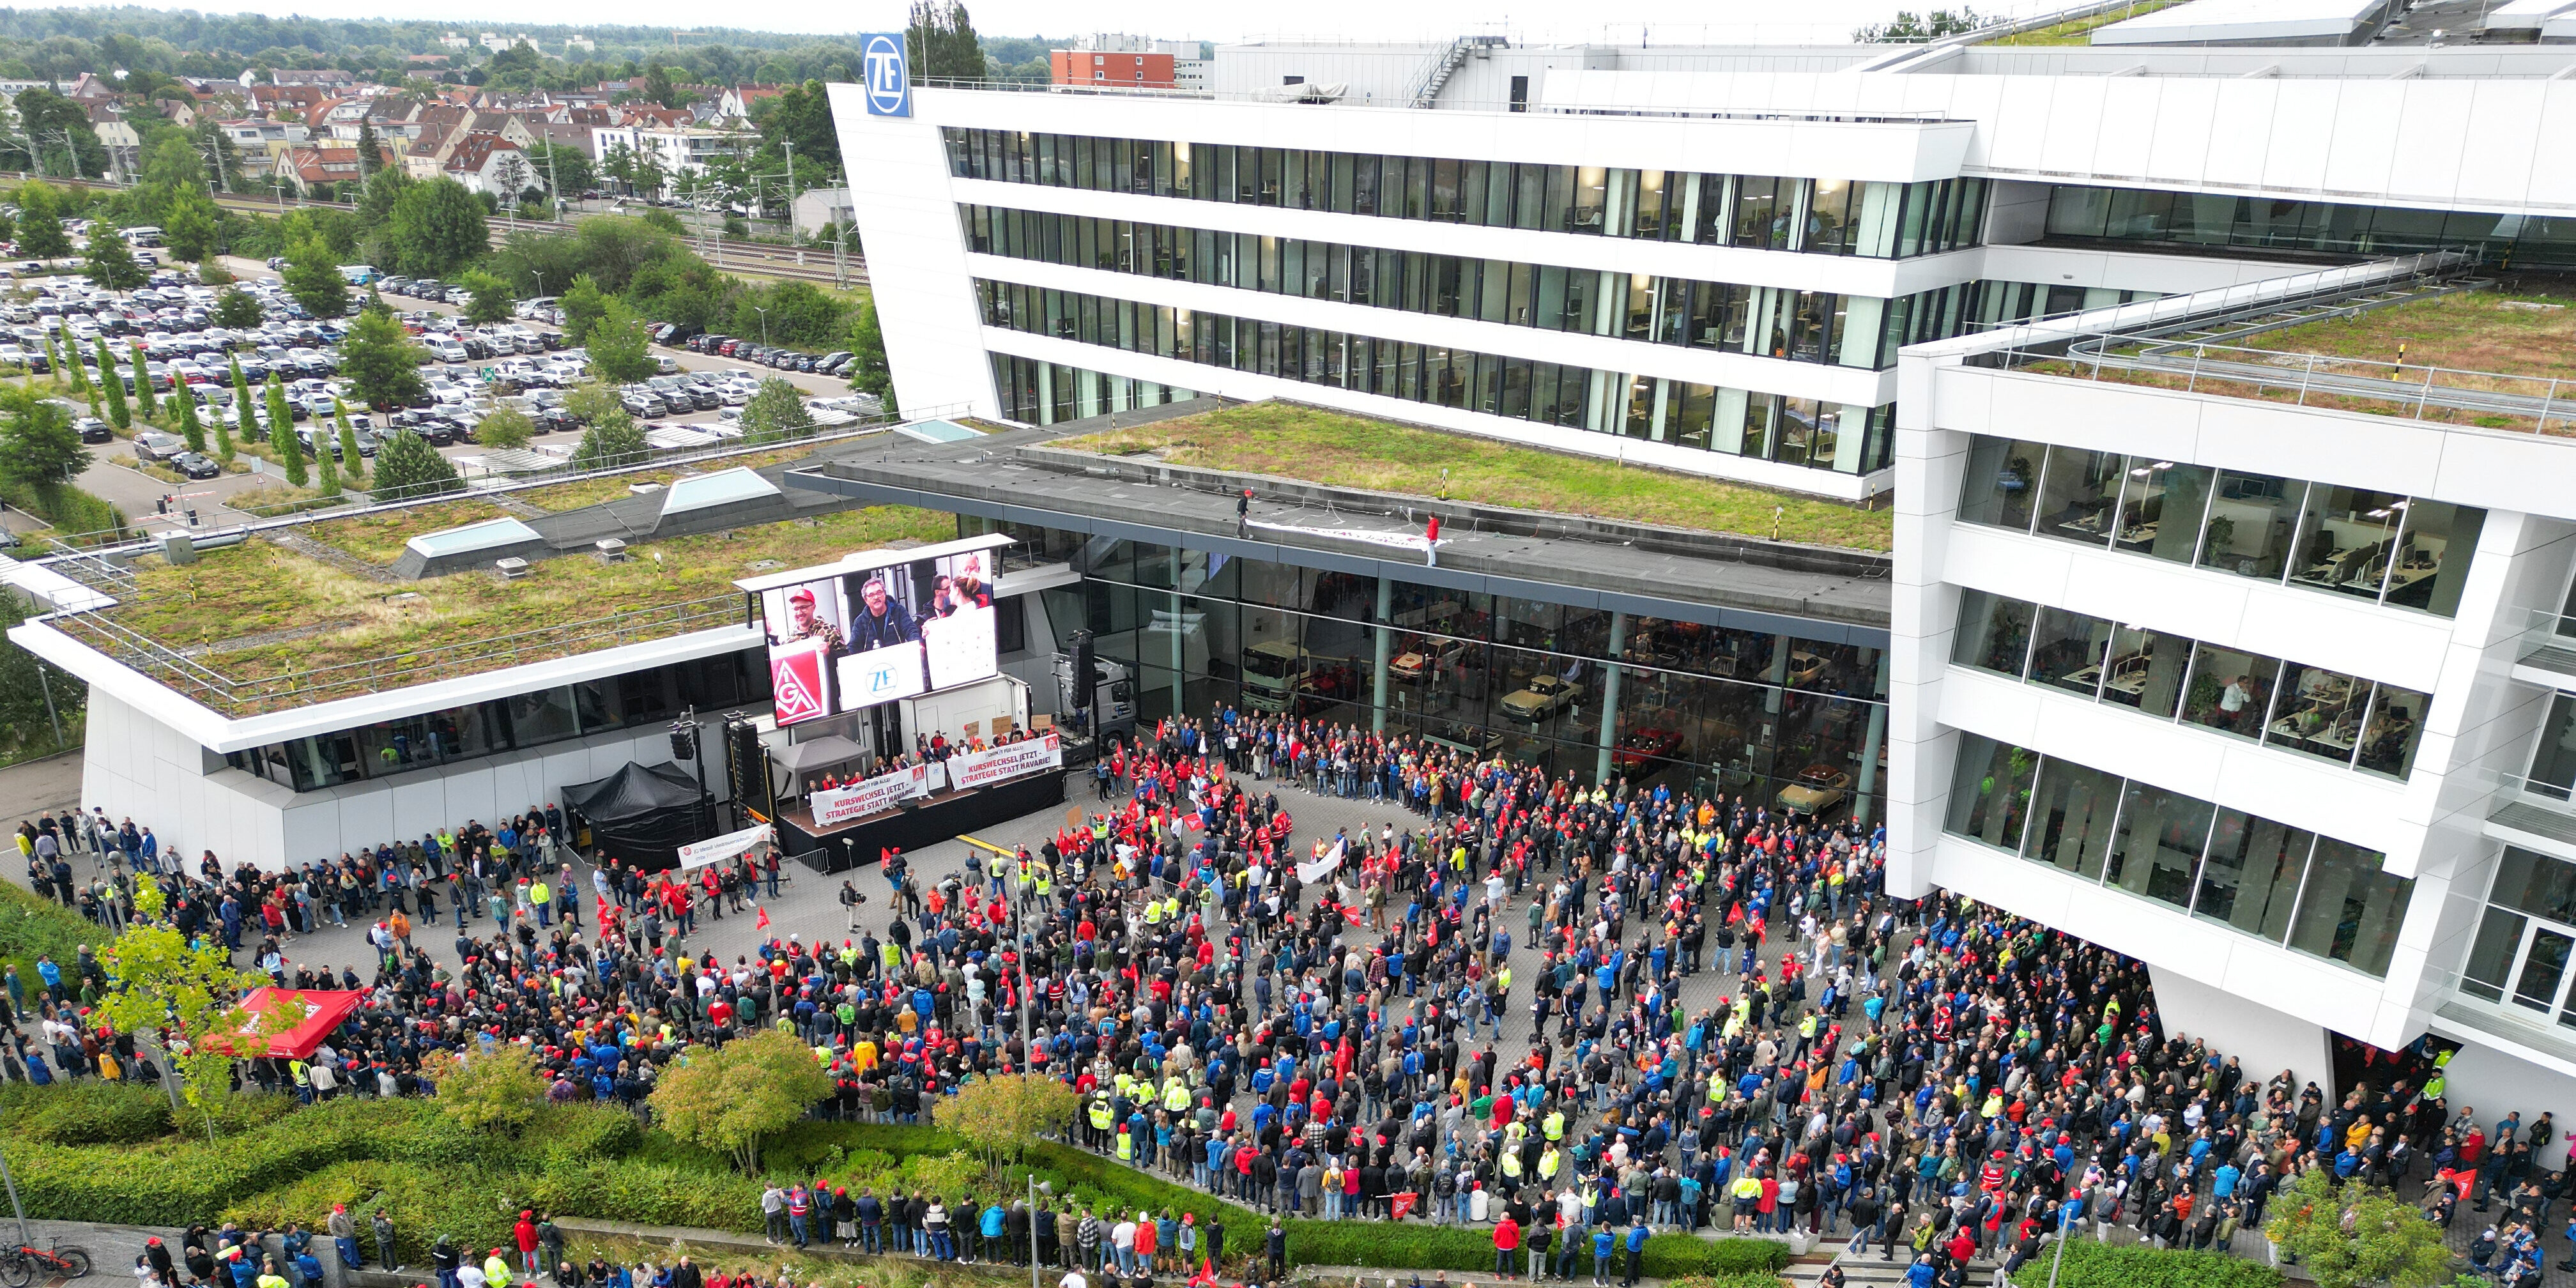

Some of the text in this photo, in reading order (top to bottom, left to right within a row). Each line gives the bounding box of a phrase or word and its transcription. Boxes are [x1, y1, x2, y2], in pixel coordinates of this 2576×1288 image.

[866, 51, 901, 98] ZF
[868, 667, 896, 692] ZF
[961, 756, 1051, 785] STRATEGIE STATT HAVARIE!
[968, 755, 1018, 772] KURSWECHSEL
[1019, 750, 1038, 763] JETZT
[834, 788, 885, 808] KURSWECHSEL
[886, 782, 905, 795] JETZT
[825, 804, 866, 820] STRATEGIE
[867, 799, 887, 810] STATT
